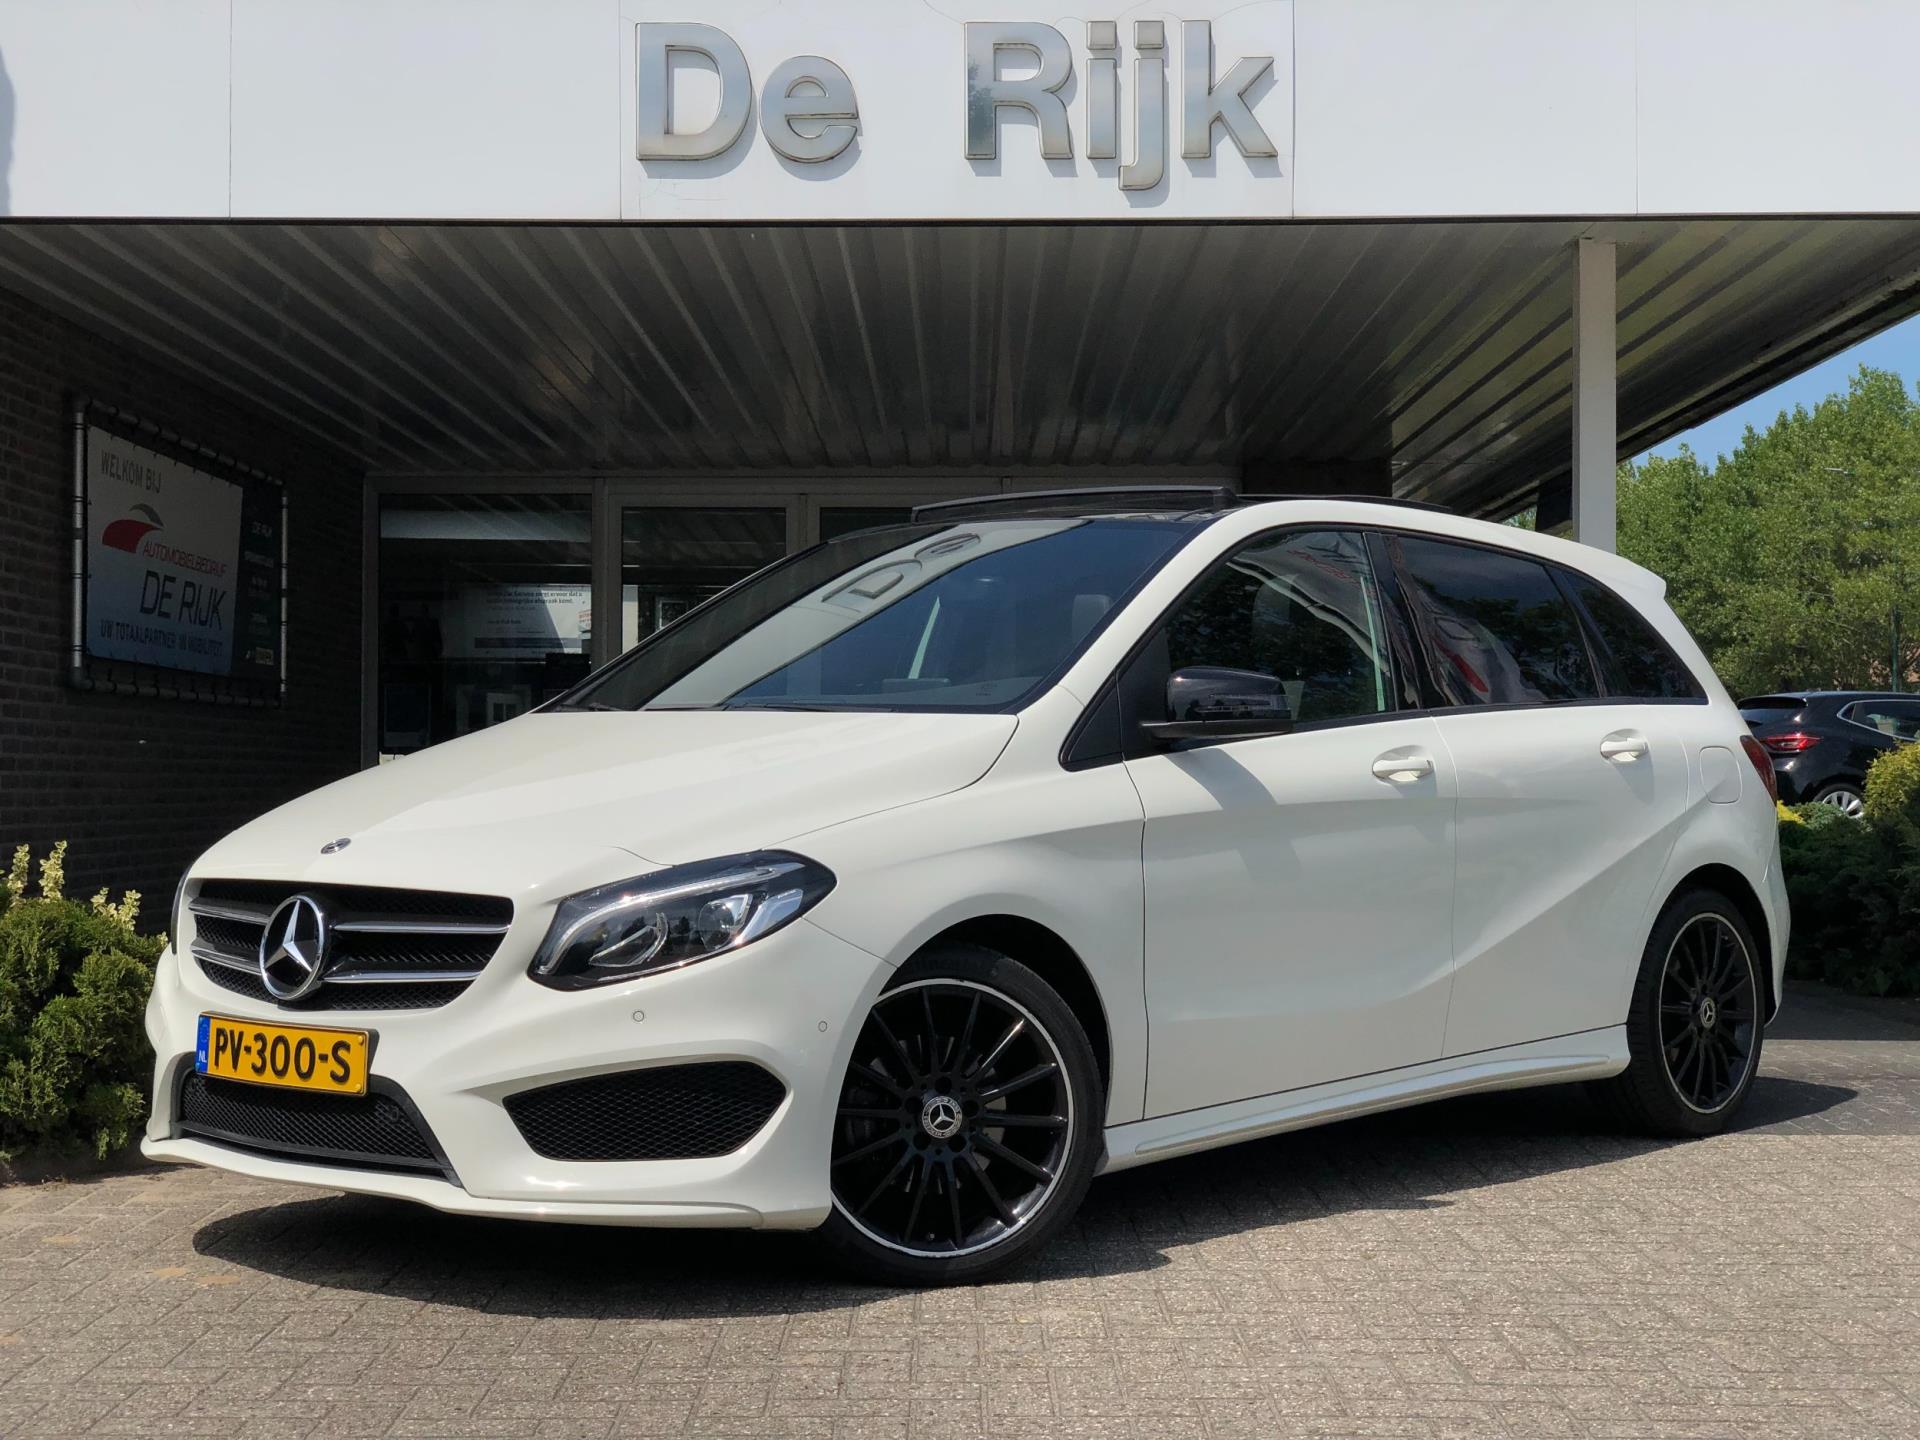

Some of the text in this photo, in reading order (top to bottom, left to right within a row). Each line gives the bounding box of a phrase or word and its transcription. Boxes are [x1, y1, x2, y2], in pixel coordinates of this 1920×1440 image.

[635, 20, 1279, 191] De Rijk
[101, 448, 162, 494] WELKOM BIJ
[139, 569, 177, 619] DE
[178, 580, 227, 631] RIJK
[100, 619, 113, 638] UW
[198, 1050, 207, 1063] NL
[214, 1027, 351, 1085] PV-300-S
